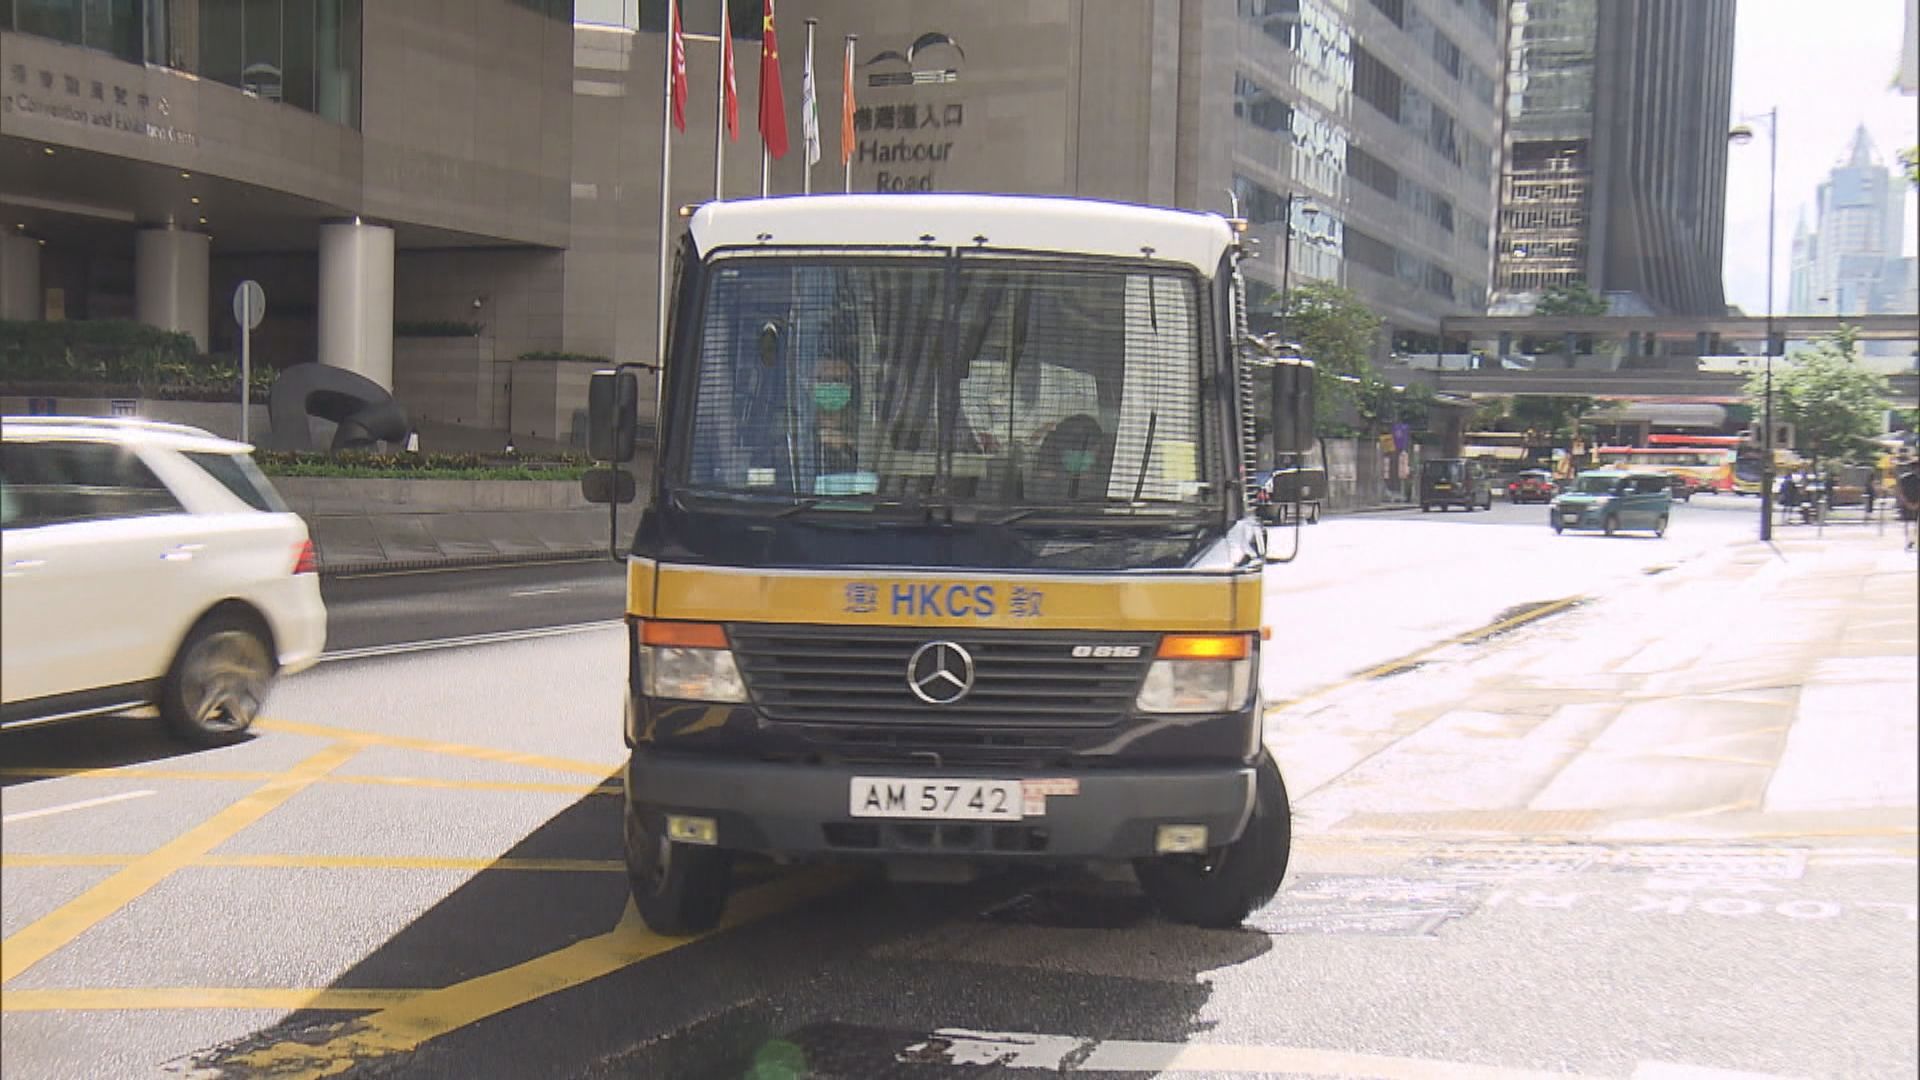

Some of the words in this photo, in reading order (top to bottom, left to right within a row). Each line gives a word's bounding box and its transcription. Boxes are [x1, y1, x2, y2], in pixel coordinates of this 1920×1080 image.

[92, 111, 113, 128] and
[859, 137, 953, 163] Harbour
[877, 169, 932, 192] Road
[891, 583, 995, 617] HKCS
[864, 783, 906, 811] AM
[921, 785, 1008, 814] 5742
